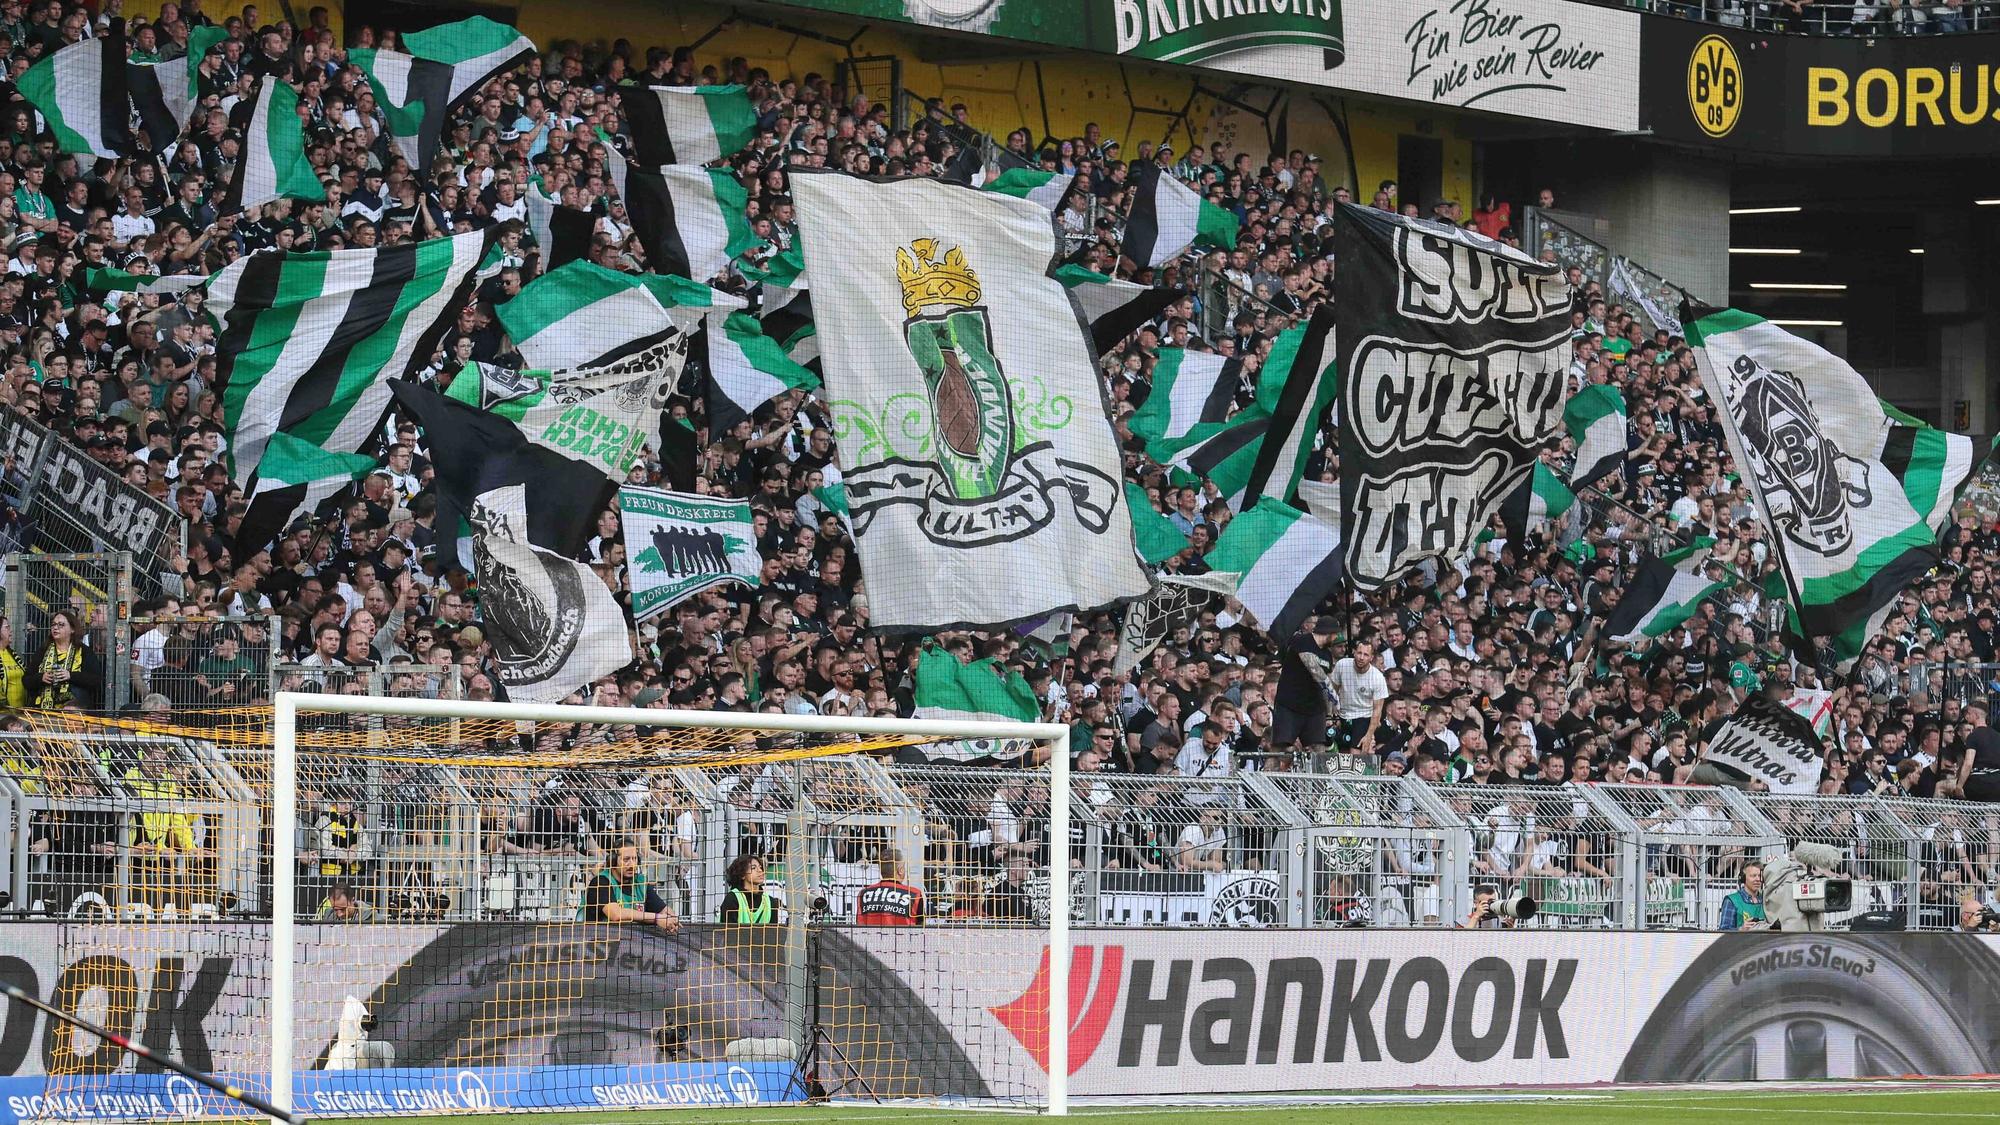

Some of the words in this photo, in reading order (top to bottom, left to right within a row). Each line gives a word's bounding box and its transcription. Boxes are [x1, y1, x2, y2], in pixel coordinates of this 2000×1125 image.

[1405, 10, 1449, 85] Ein
[1450, 0, 1522, 47] Bier
[1432, 61, 1468, 100] wie
[1474, 46, 1516, 80] sein
[1520, 23, 1604, 79] Revier
[1696, 45, 1736, 108] BVB
[1807, 63, 2000, 128] BORU
[1708, 104, 1723, 126] 09
[624, 496, 736, 519] FREUNDESKREIS
[862, 888, 911, 906] atlas
[884, 904, 906, 914] SHOES
[9, 1093, 95, 1119] SIGNAL
[98, 1094, 163, 1118] IDUNA
[313, 1089, 397, 1112] SIGNAL
[399, 1089, 454, 1111] IDUNA
[591, 1086, 665, 1105] SIGNAL
[669, 1084, 731, 1103] IDUNA
